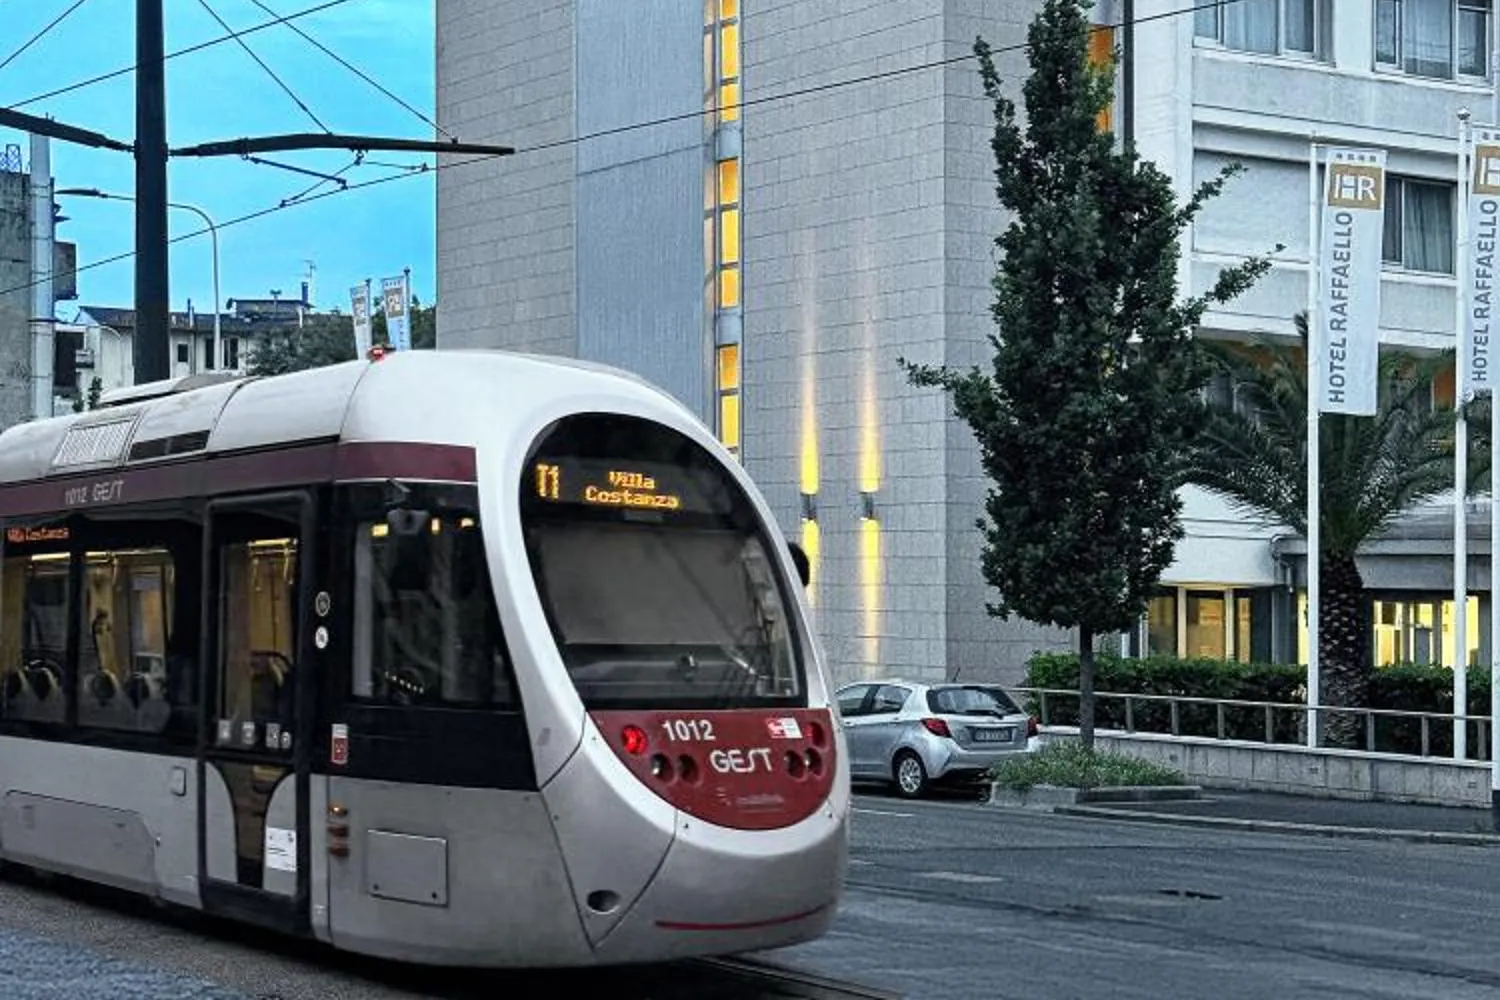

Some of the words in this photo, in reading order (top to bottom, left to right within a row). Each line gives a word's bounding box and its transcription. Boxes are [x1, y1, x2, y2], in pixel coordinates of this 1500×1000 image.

[1330, 211, 1353, 334] RAFFAELLO
[1474, 199, 1498, 319] RAFFAELLO
[1472, 324, 1490, 382] HOTEL
[1329, 337, 1347, 404] HOTEL
[92, 480, 124, 501] GEST
[536, 463, 559, 499] T1
[609, 471, 655, 489] Villa
[585, 485, 679, 509] Costanza
[663, 720, 716, 741] 1012
[709, 748, 773, 773] GEST
